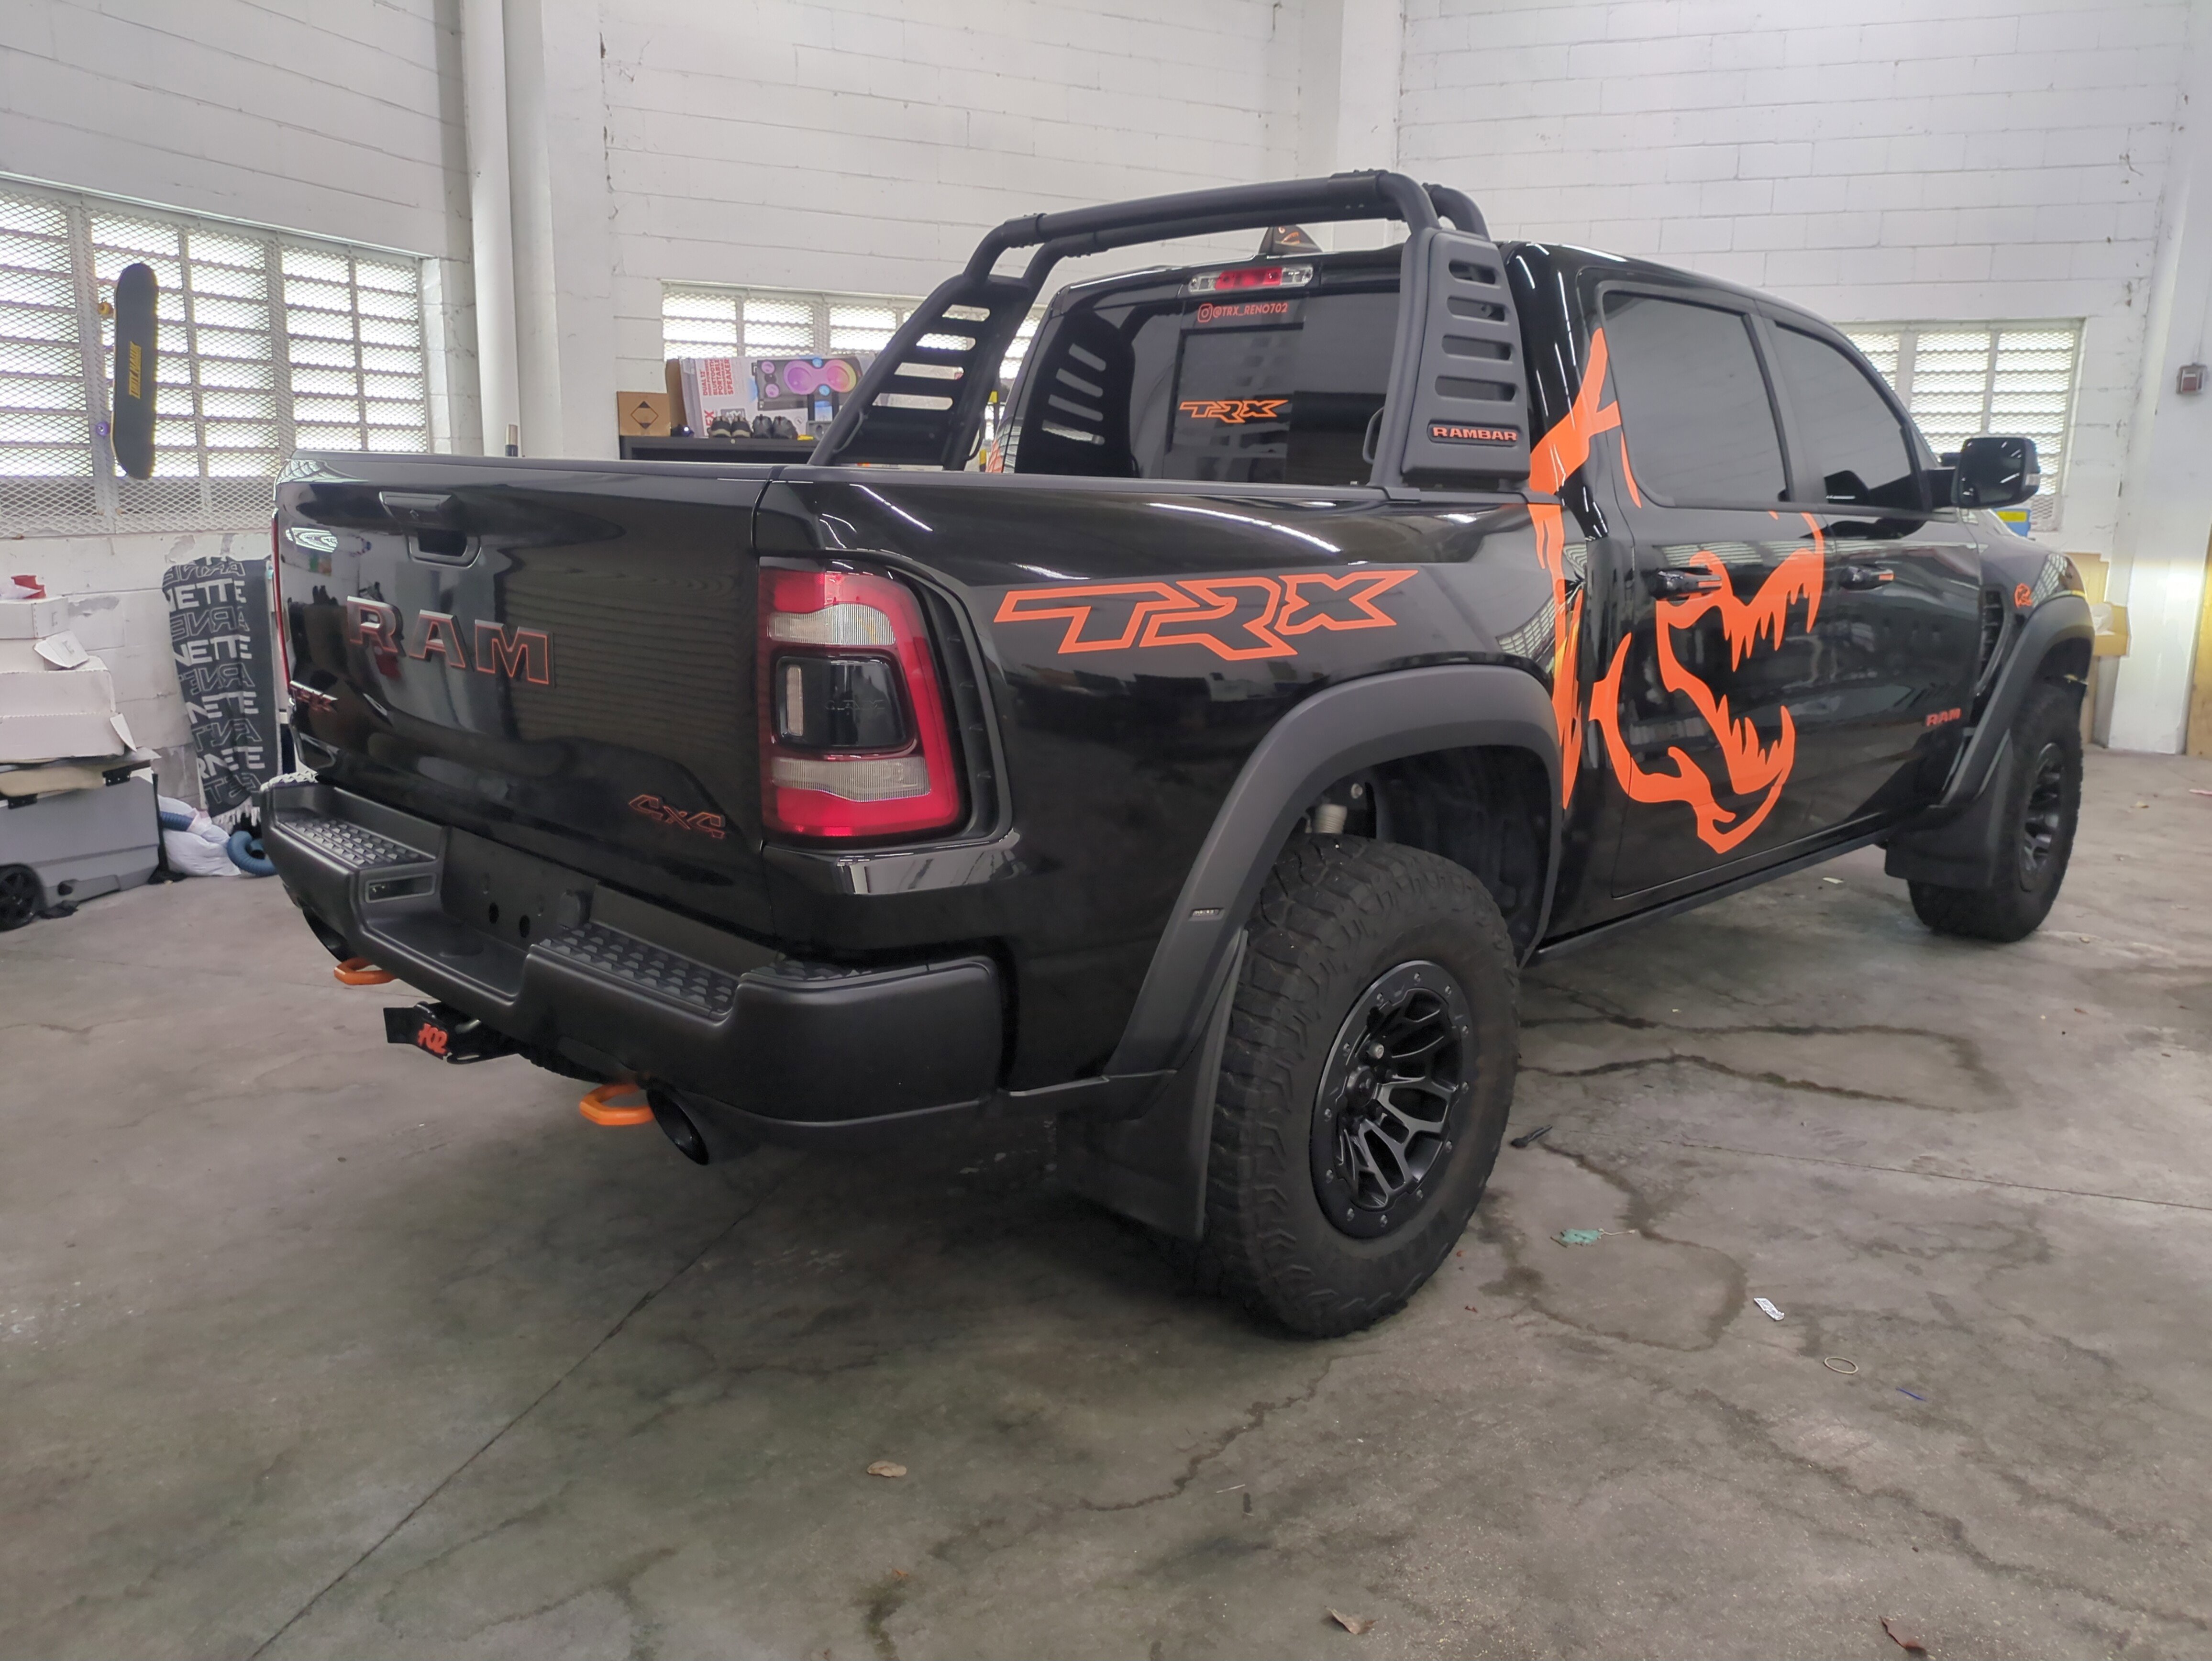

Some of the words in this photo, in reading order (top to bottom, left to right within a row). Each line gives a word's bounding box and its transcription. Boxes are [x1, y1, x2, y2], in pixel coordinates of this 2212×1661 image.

[1212, 301, 1289, 319] @TRX_RENO702
[709, 359, 718, 396] BLUETOOTH
[714, 359, 723, 395] PORTABLE
[724, 359, 734, 395] SPEAKER
[1179, 399, 1289, 423] TRX
[1432, 427, 1518, 442] RAMBAR
[993, 570, 1419, 661] TRX
[347, 596, 554, 687] RAM
[1926, 708, 1961, 727] RAM
